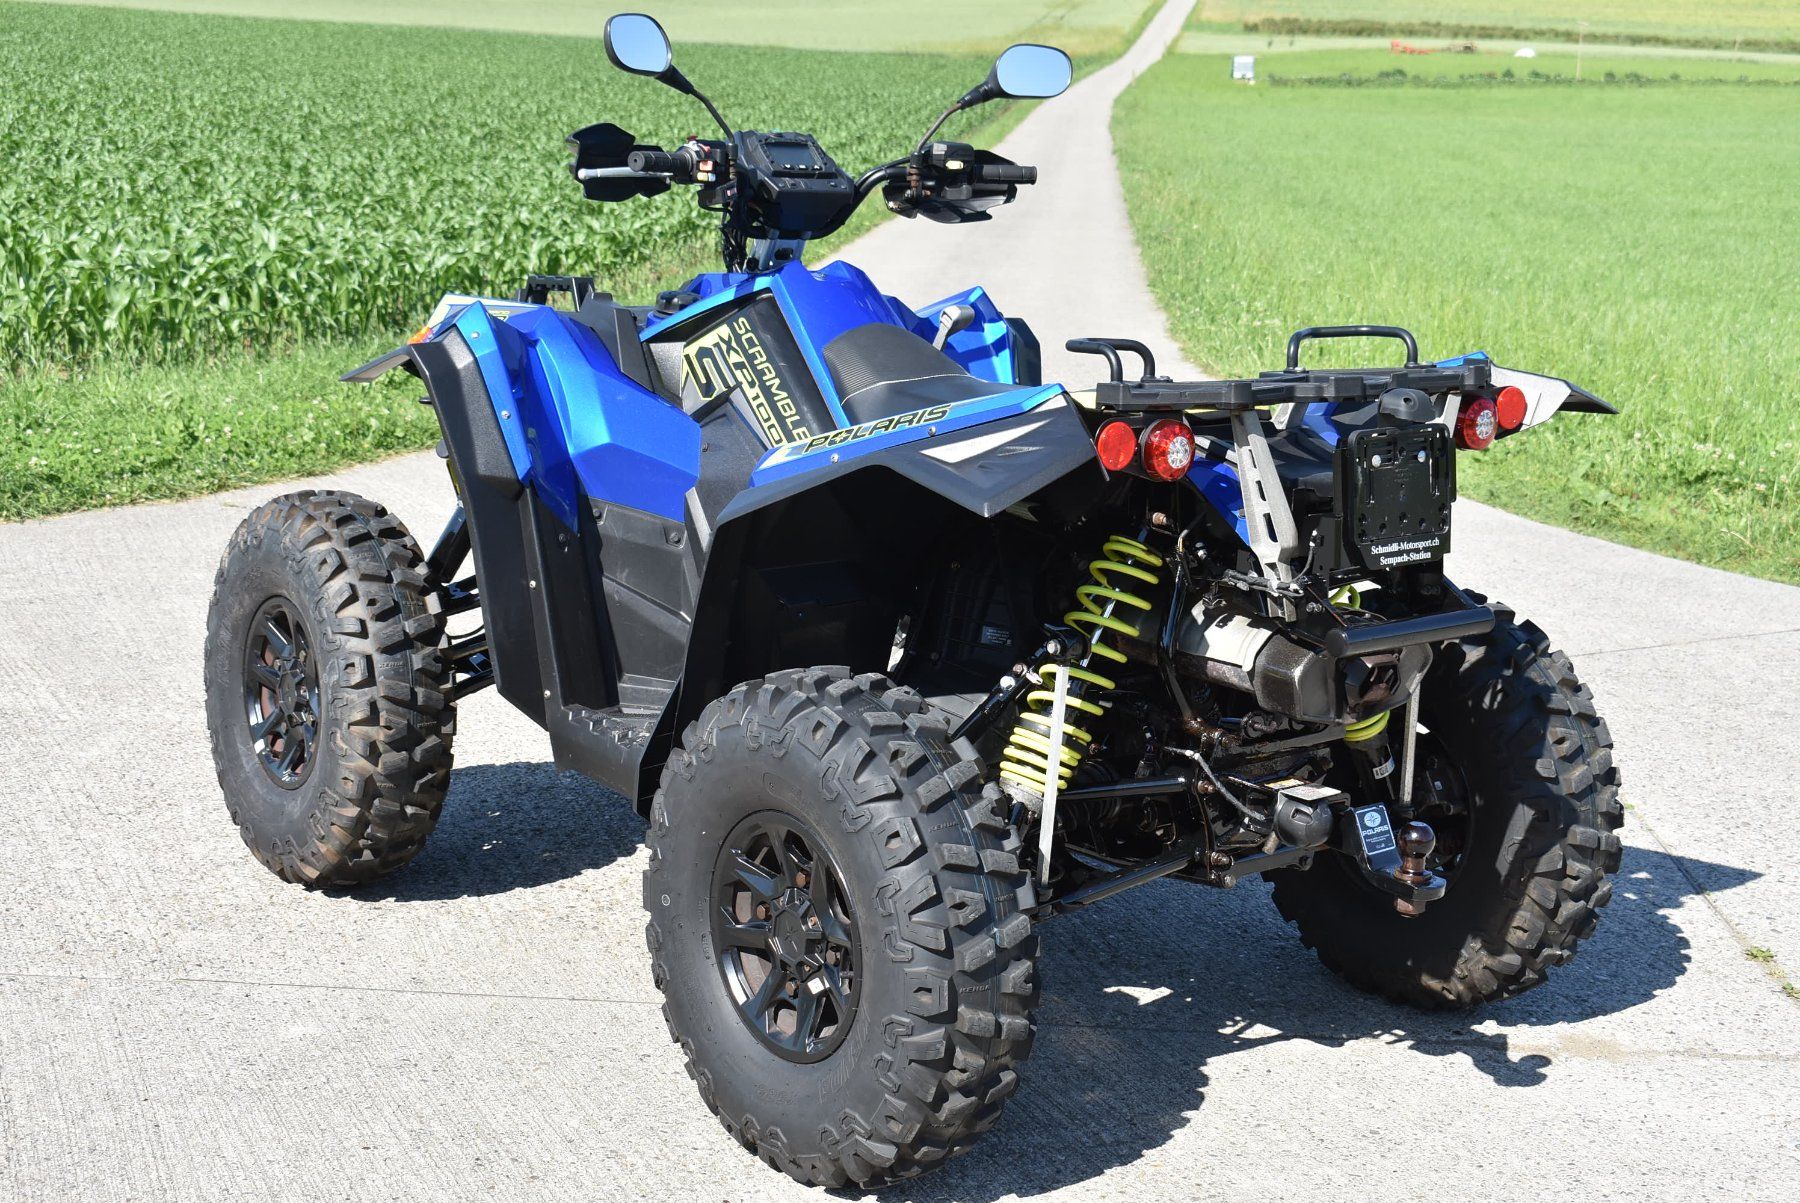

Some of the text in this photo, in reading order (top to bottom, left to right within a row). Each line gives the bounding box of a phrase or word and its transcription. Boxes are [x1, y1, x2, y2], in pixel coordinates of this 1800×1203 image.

[803, 403, 952, 454] POLARIS
[1371, 537, 1439, 554] Schmidli-Motorsport.ch
[1380, 551, 1431, 565] Sempach-Station
[1362, 825, 1388, 836] POLARIS
